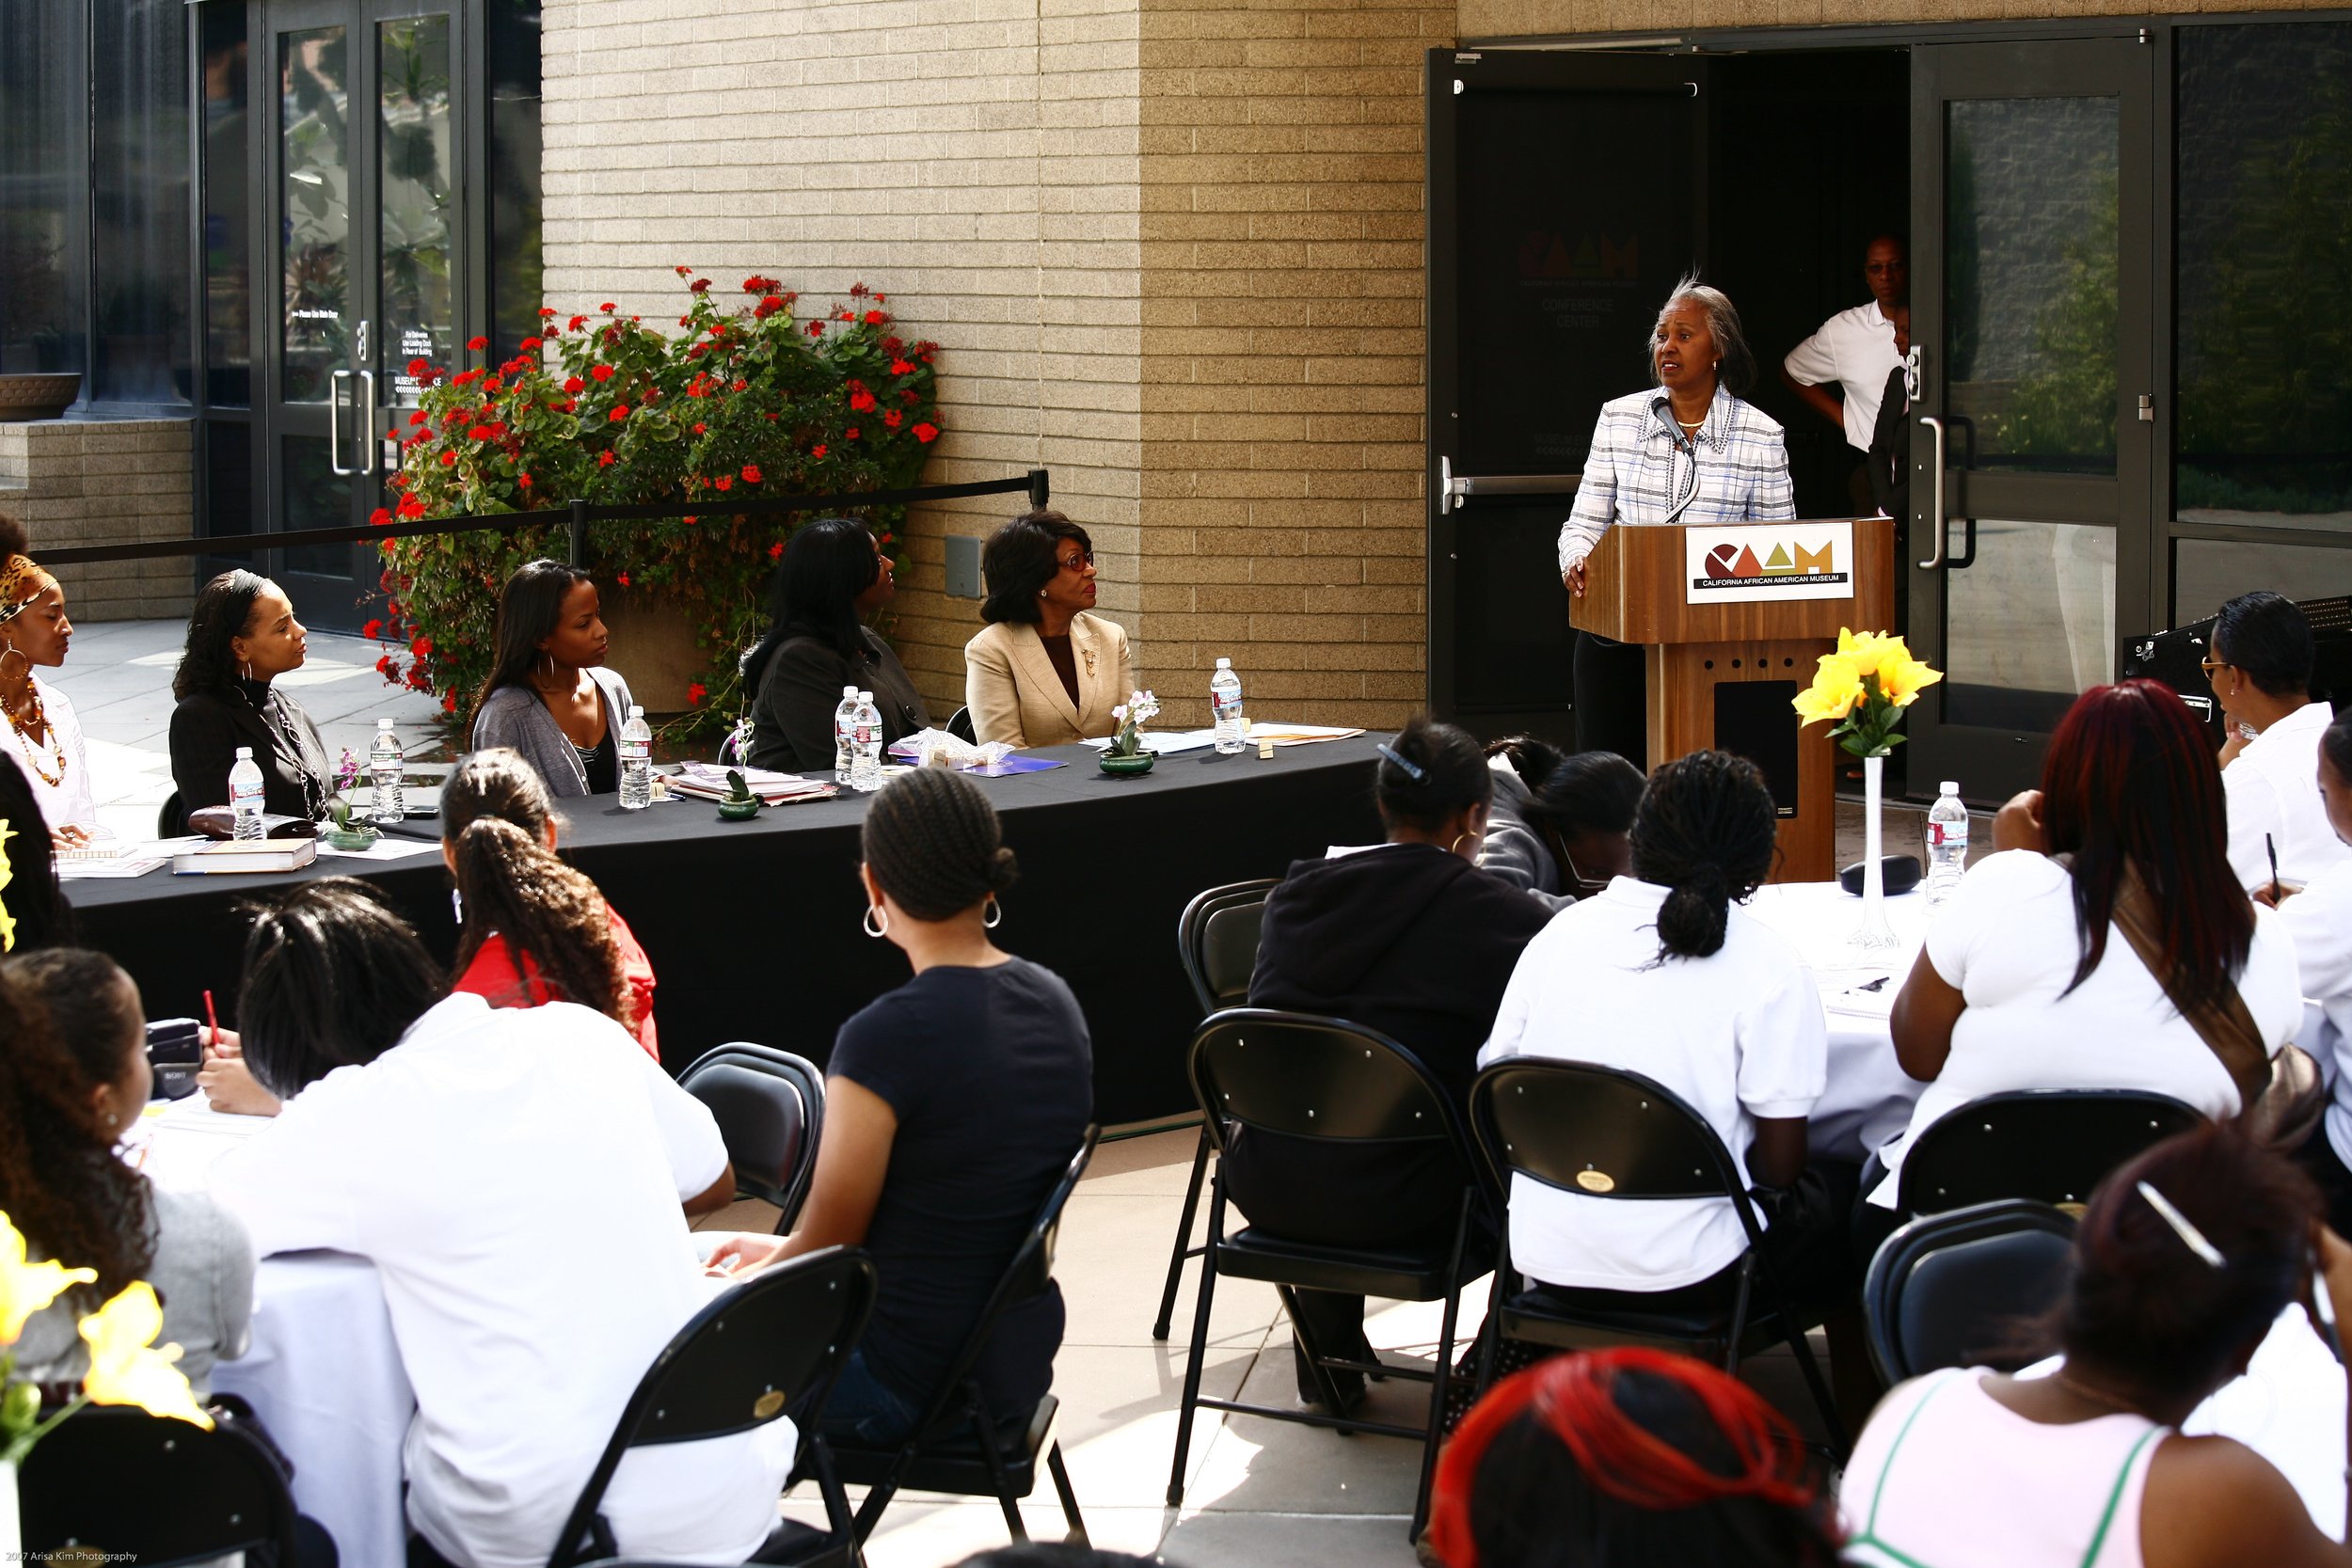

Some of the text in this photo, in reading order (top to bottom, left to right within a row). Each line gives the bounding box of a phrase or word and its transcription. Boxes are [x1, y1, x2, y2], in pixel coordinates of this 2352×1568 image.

[1542, 298, 1613, 312] CONFERENCE
[1556, 315, 1599, 327] CENTER
[1534, 433, 1573, 445] MUSEUM
[1702, 578, 1742, 587] CALIFORNIA
[1743, 577, 1772, 585] AFRICAN
[1773, 576, 1808, 584] AMERICAN
